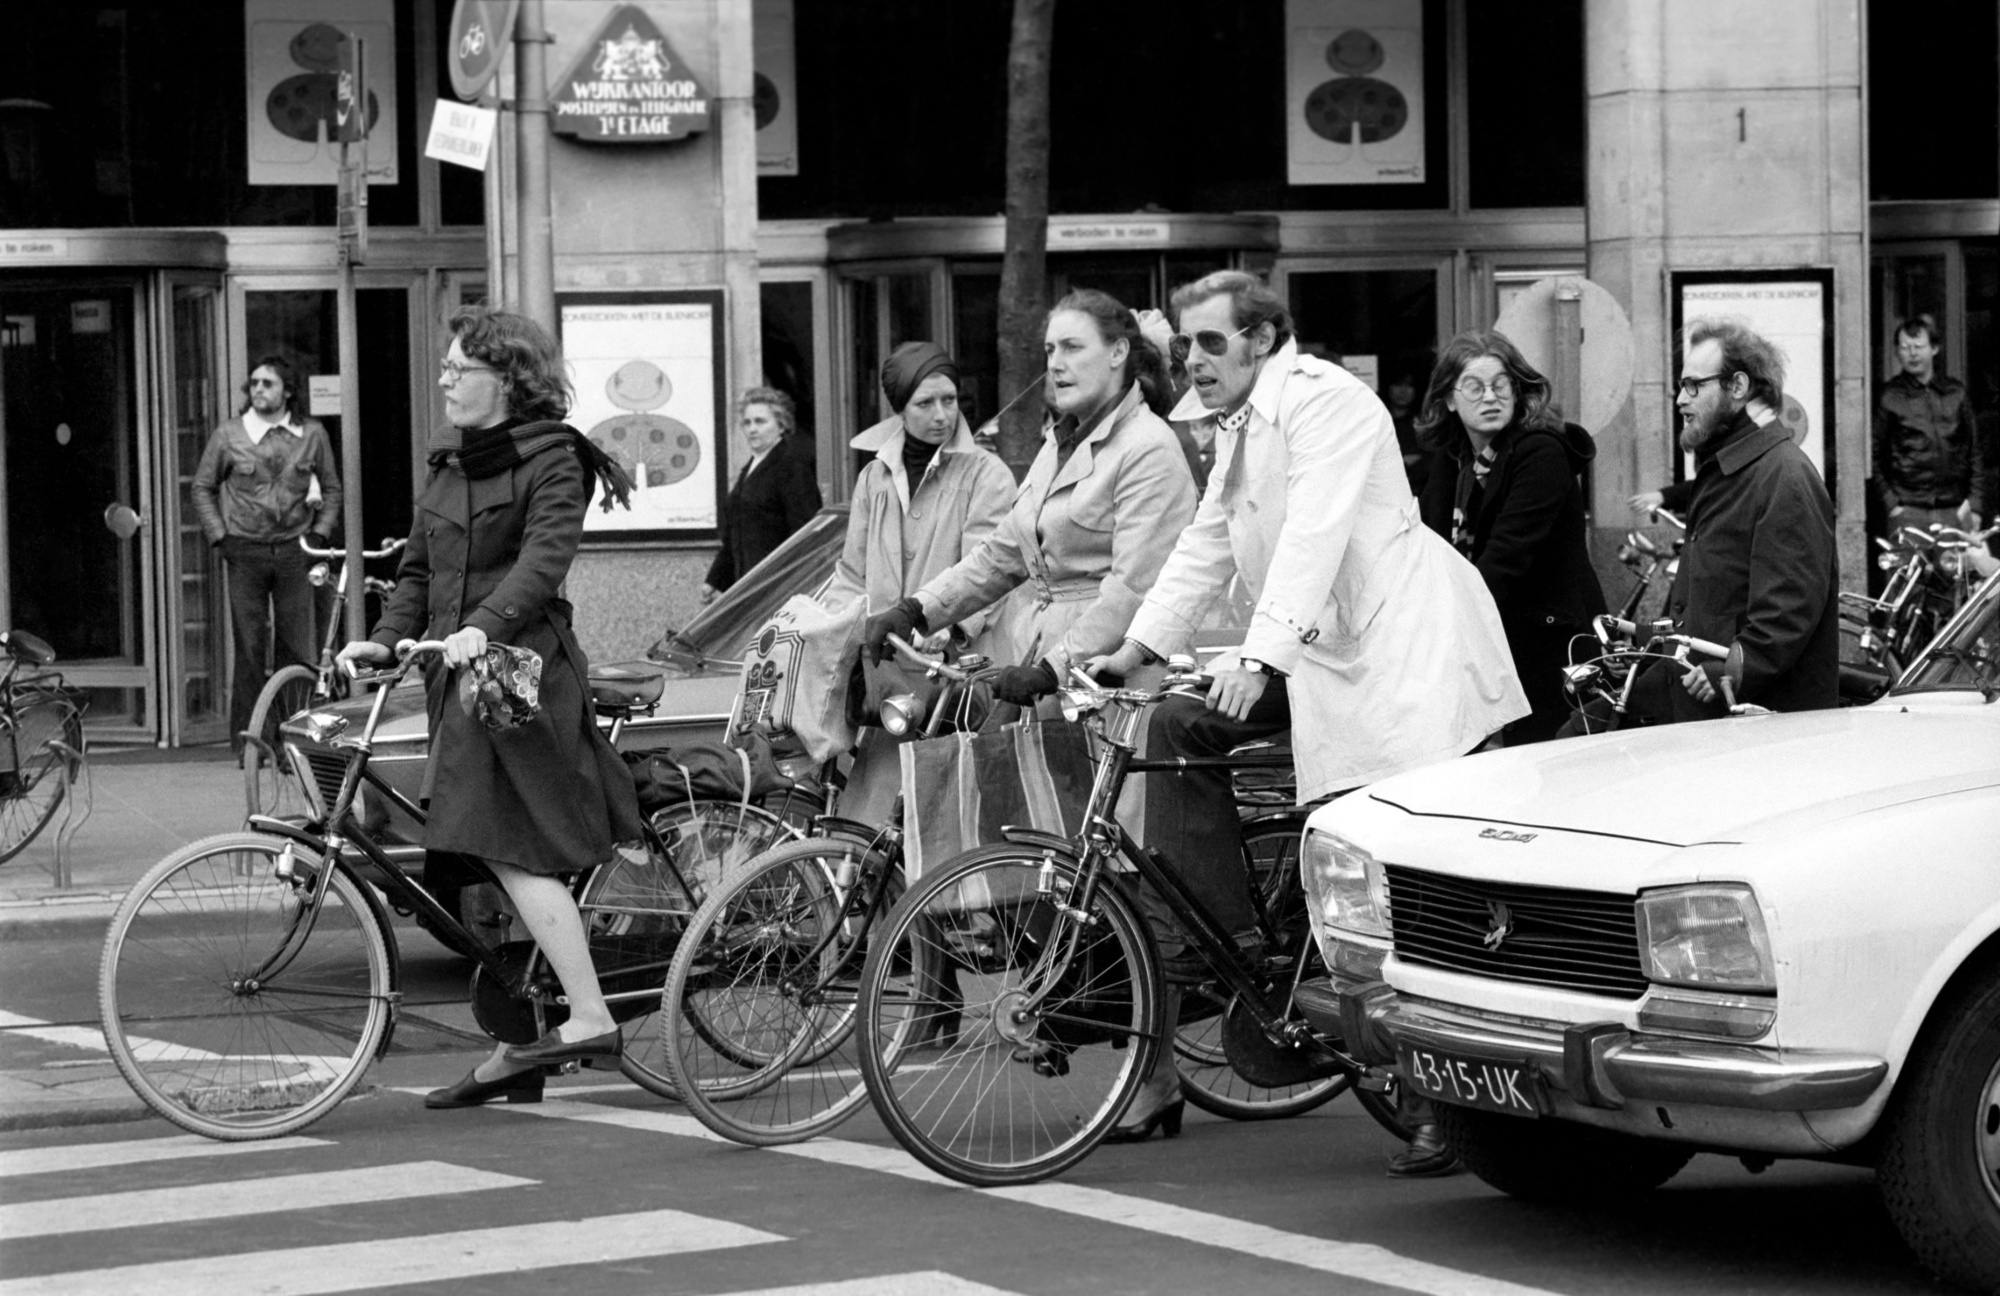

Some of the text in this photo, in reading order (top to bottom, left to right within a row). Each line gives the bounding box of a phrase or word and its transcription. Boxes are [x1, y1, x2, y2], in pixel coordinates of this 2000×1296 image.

[617, 116, 671, 135] ETAGE
[1735, 106, 1746, 142] 1
[21, 242, 54, 253] roken
